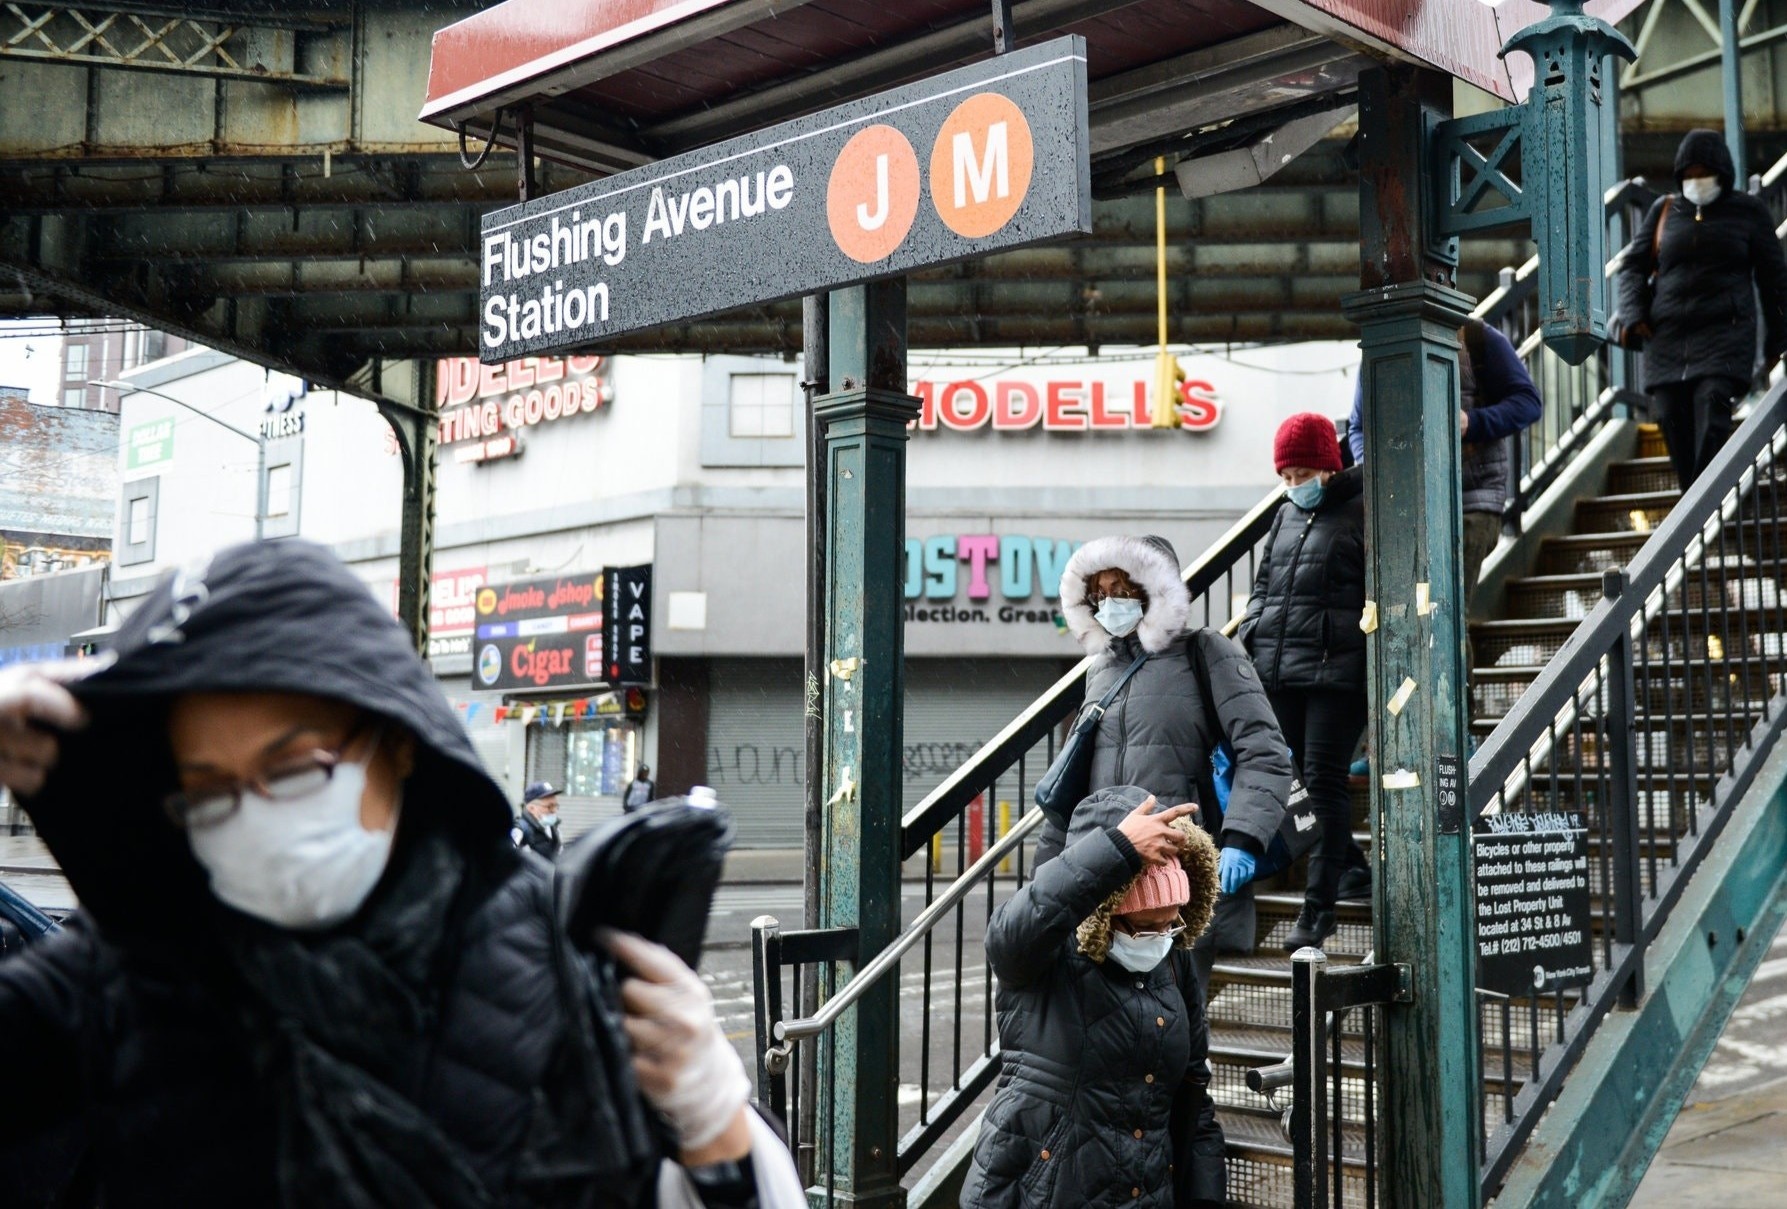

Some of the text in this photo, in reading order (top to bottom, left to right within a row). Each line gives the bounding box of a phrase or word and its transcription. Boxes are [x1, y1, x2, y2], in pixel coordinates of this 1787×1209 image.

[856, 121, 1009, 231] J M
[484, 165, 794, 286] Flushing Avenue
[483, 280, 609, 347] Station
[506, 376, 602, 429] GOODS
[629, 581, 644, 664] VAPE
[998, 605, 1059, 624] Great
[511, 641, 574, 685] Cigar
[1439, 778, 1457, 788] ING AV
[1476, 840, 1575, 859] Bicycles or other property
[1477, 856, 1587, 877] attached to these railings will
[1477, 876, 1585, 897] be removed and delivered to
[1478, 895, 1564, 916] the Lost Property Unit
[1479, 913, 1572, 936] located at 34 St & 8 Av
[1479, 941, 1499, 956] Tel.#
[1501, 937, 1520, 955] (212)
[1566, 967, 1576, 978] City
[1575, 965, 1591, 975] Transit
